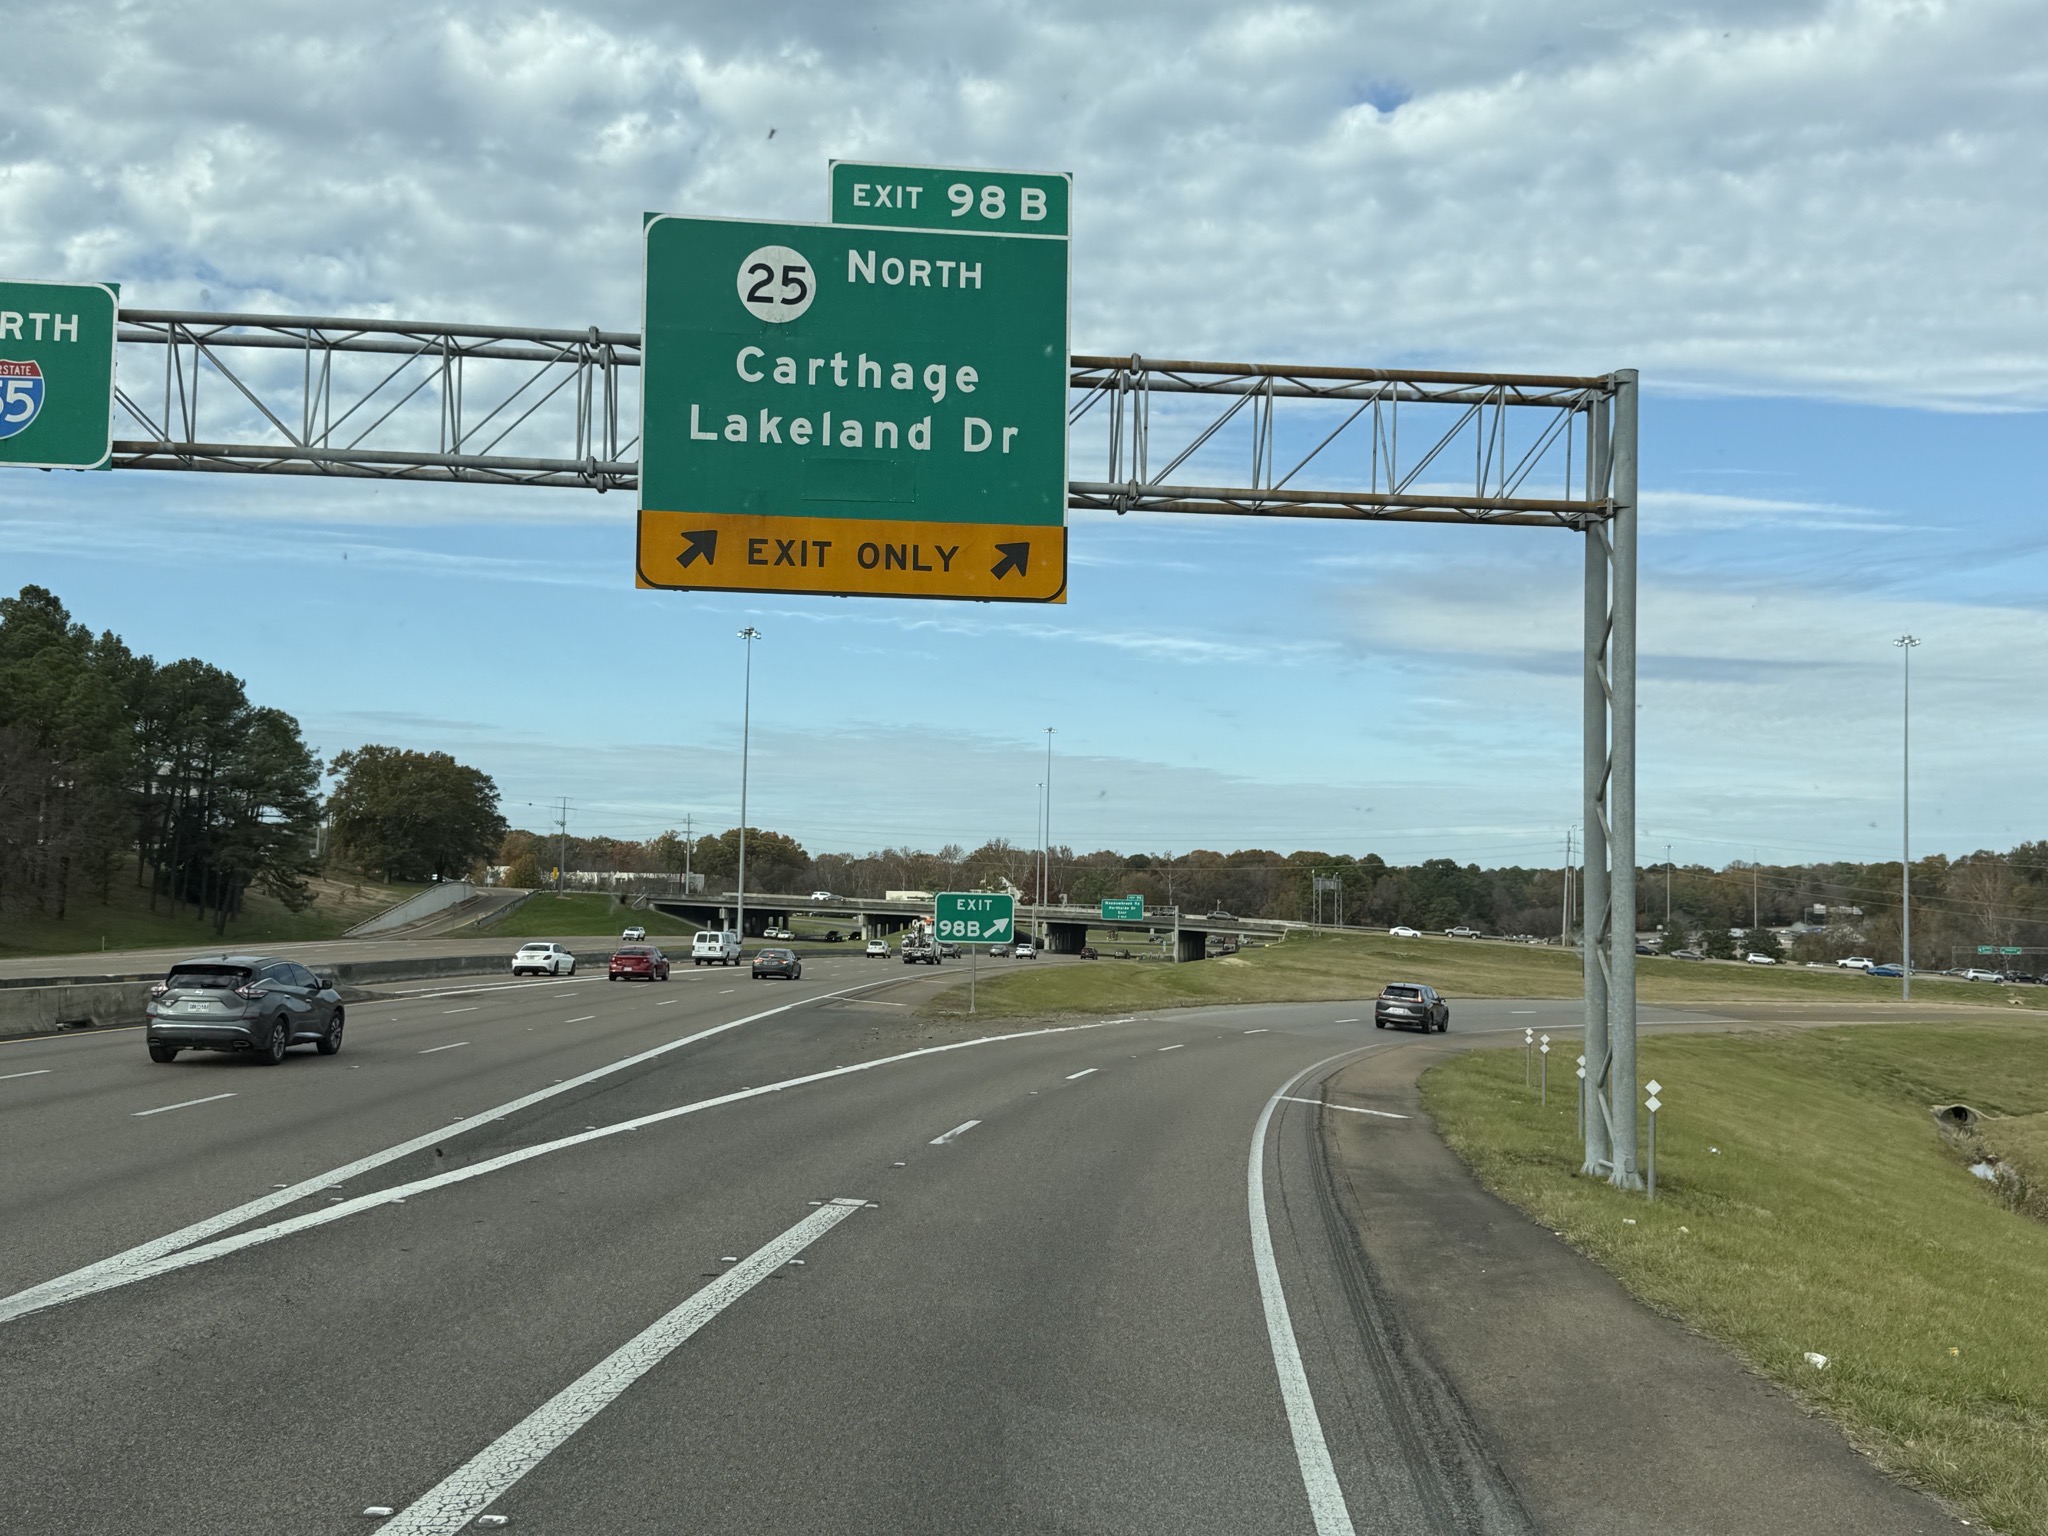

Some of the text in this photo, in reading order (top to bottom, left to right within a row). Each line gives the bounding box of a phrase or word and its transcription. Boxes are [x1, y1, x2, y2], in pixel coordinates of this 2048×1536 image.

[853, 183, 1048, 221] EXIT 98 B
[746, 262, 808, 306] 25
[848, 249, 982, 290] NORTH
[736, 345, 979, 403] Carthage
[0, 380, 34, 422] 5
[690, 404, 1018, 453] Lakeland Dr
[748, 538, 960, 572] EXIT ONLY
[957, 899, 993, 911] EXIT
[939, 920, 980, 937] 98B
